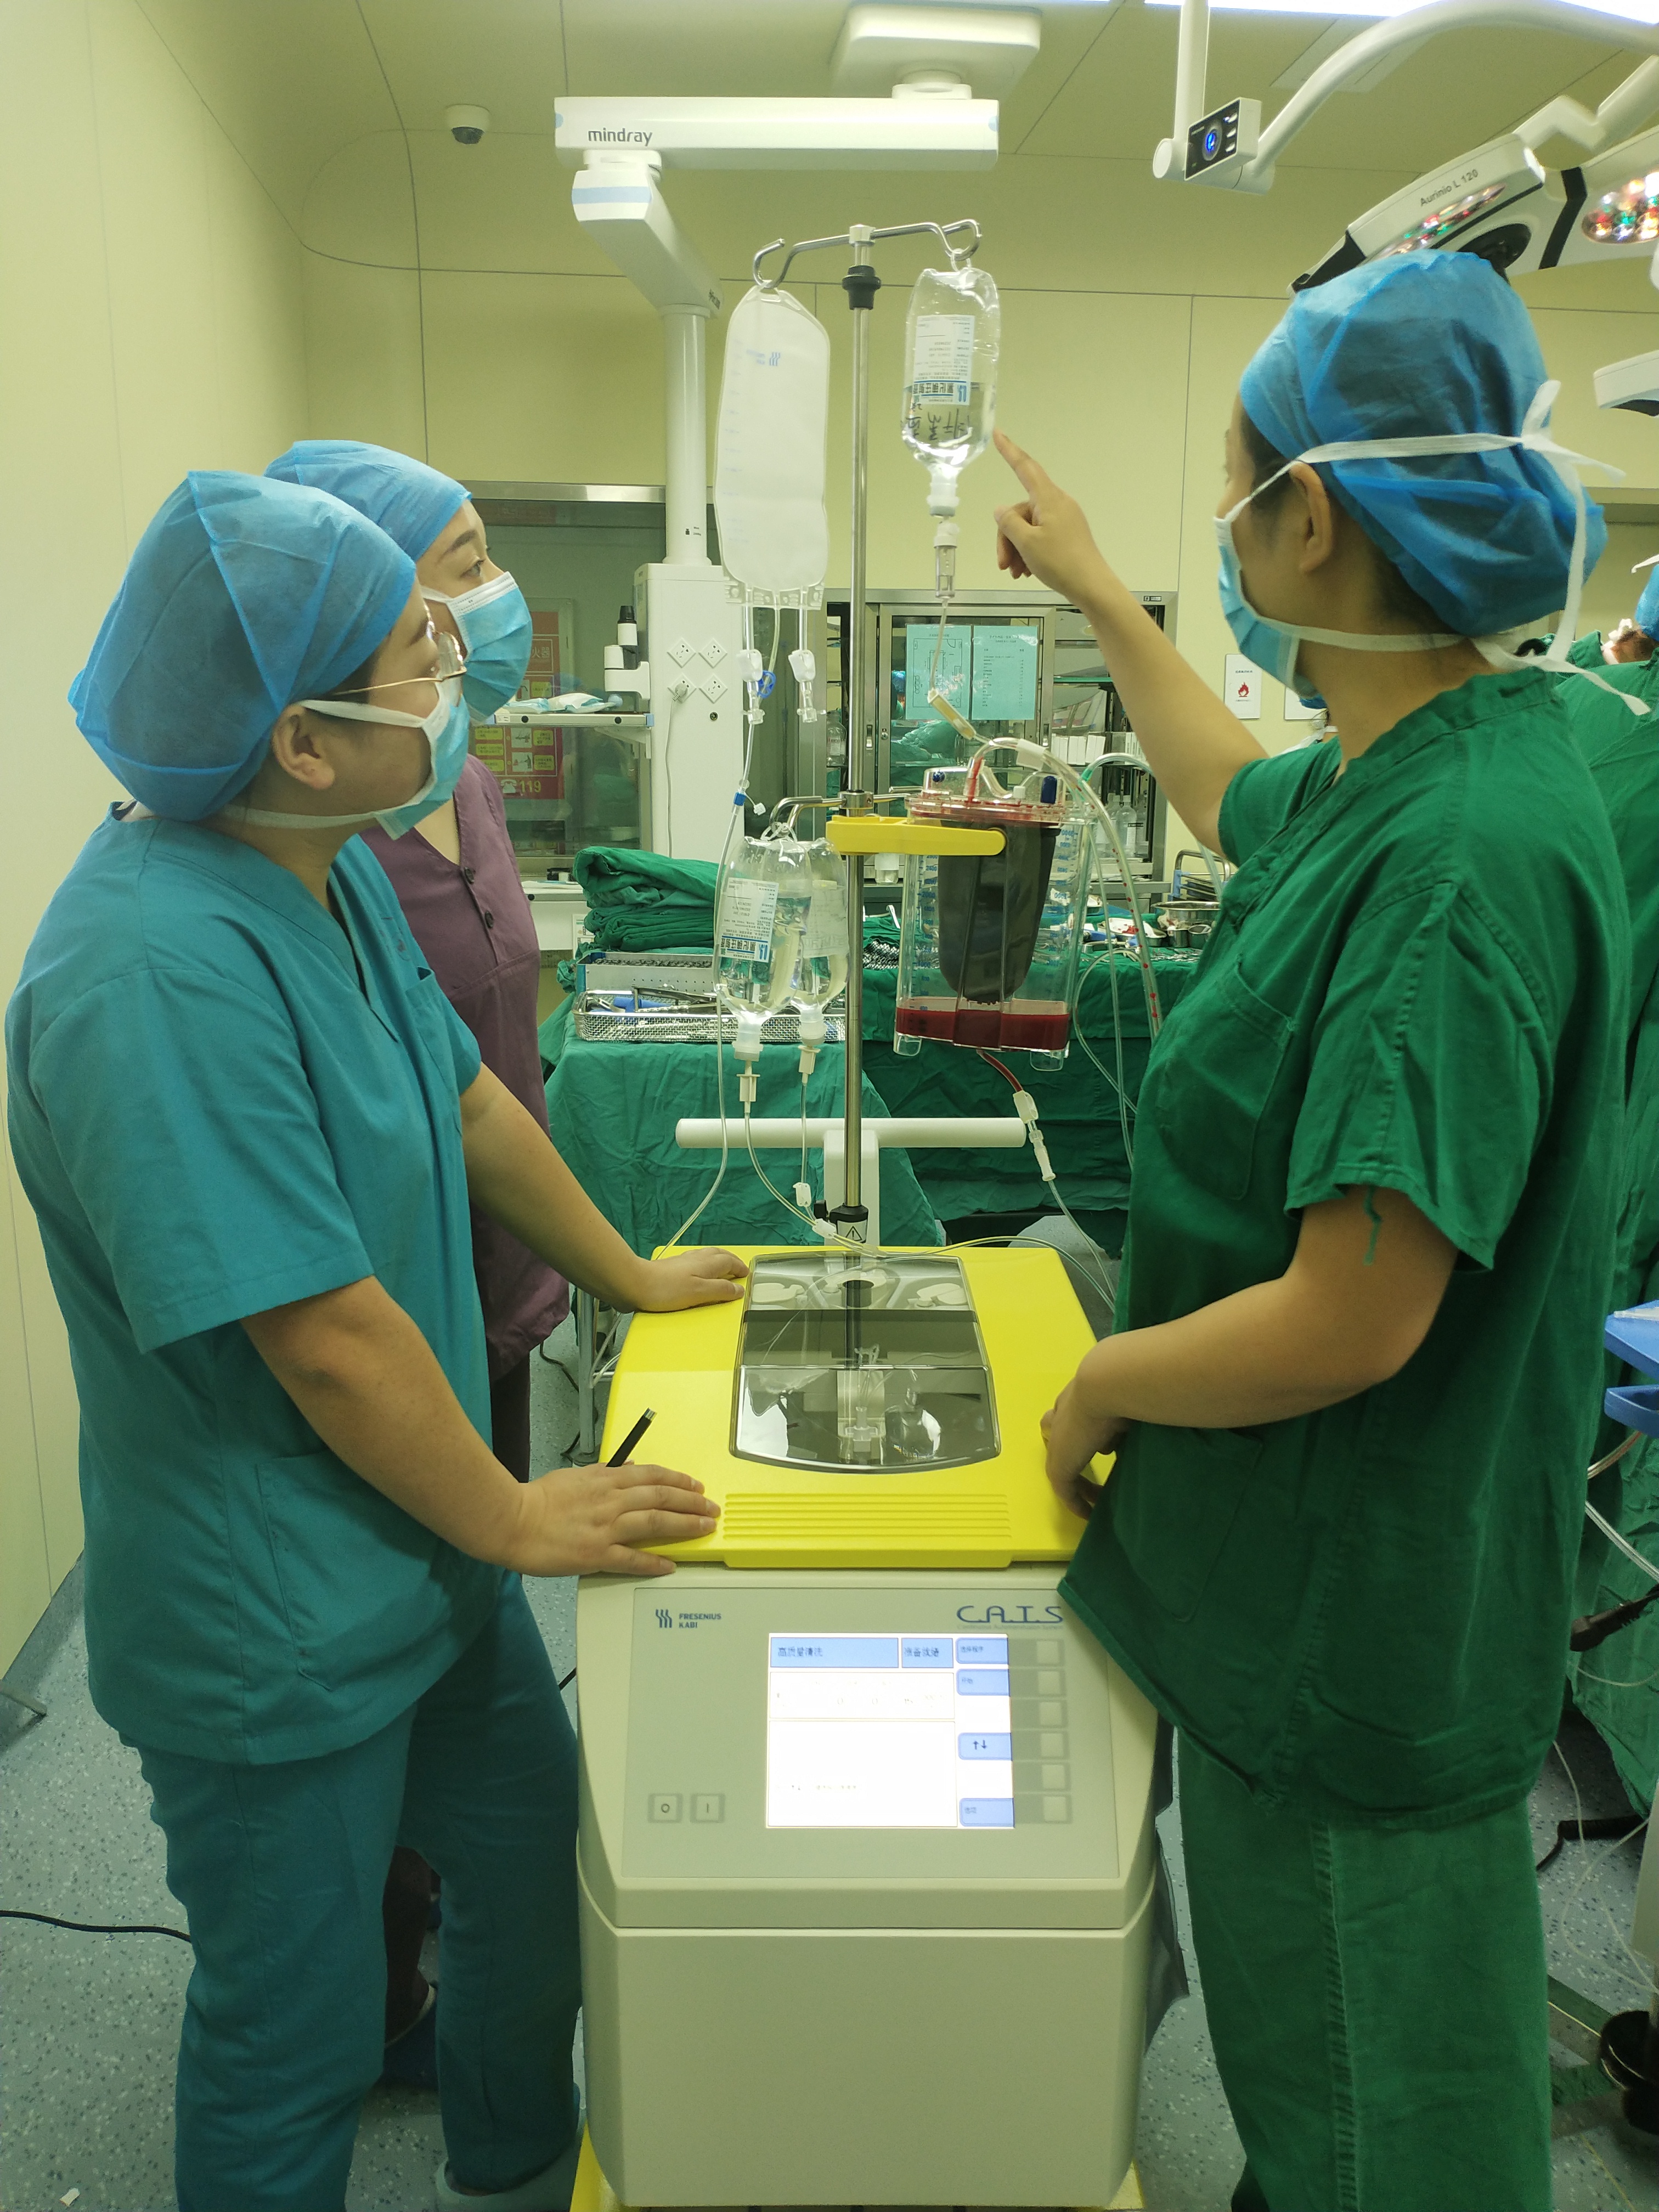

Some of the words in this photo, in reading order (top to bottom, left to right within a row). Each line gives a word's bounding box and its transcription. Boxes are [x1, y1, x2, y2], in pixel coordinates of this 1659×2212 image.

[588, 127, 653, 146] mindray
[1420, 185, 1452, 206] Aurinio
[1452, 180, 1461, 188] L
[1461, 169, 1479, 183] 120
[519, 780, 541, 793] 119
[720, 938, 757, 952] 氯化钠注射液
